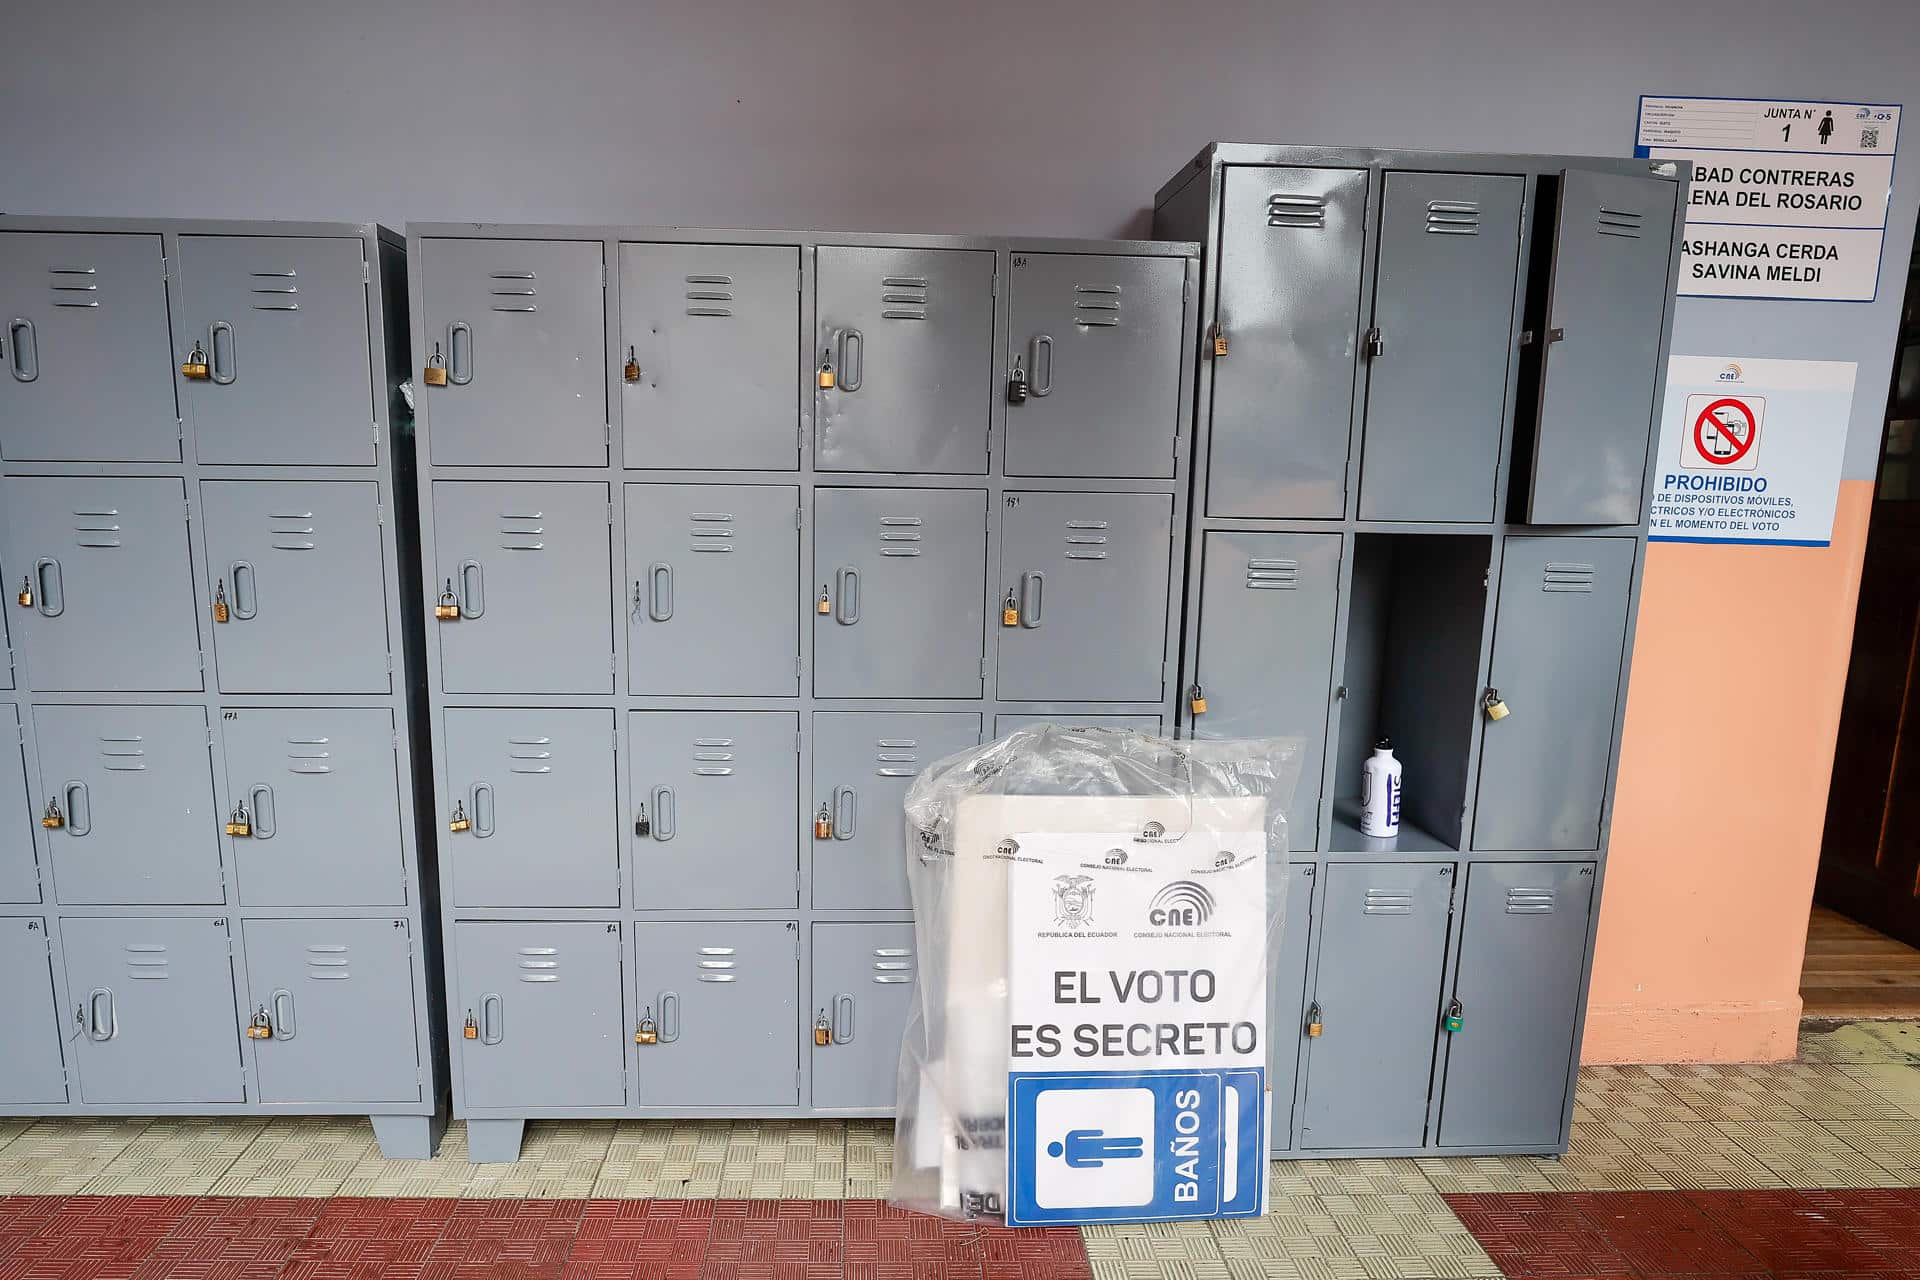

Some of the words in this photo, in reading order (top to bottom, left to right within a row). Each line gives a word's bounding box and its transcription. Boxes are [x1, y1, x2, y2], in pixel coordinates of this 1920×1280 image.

[1764, 108, 1800, 119] JUNTA
[1782, 124, 1791, 142] 1
[1690, 167, 1734, 183] BAD
[1739, 169, 1855, 187] CONTRERAS
[1687, 190, 1730, 206] ENA
[1735, 192, 1771, 207] DEL
[1776, 193, 1862, 210] ROSARIO
[1776, 244, 1839, 260] CERDA
[1692, 264, 1761, 280] SAVINA
[1766, 266, 1821, 282] MELDI
[1665, 475, 1767, 492] PROHIBIDO
[1657, 493, 1672, 502] DE
[1674, 494, 1744, 505] DISPOSITIVOS
[1746, 495, 1794, 507] MÓVILES,
[1698, 507, 1715, 516] Y/O
[1718, 508, 1796, 519] ELECTRÓNICOS
[1660, 519, 1672, 528] EL
[1675, 520, 1727, 529] MOMENTO
[1729, 521, 1749, 530] DEL
[1752, 522, 1780, 531] VOTO
[1054, 971, 1101, 1004] EL
[1109, 969, 1216, 1003] VOTO
[1011, 1024, 1061, 1057] ES
[1073, 1021, 1257, 1057] SECRETO
[1170, 1089, 1200, 1202] BAÑOS
